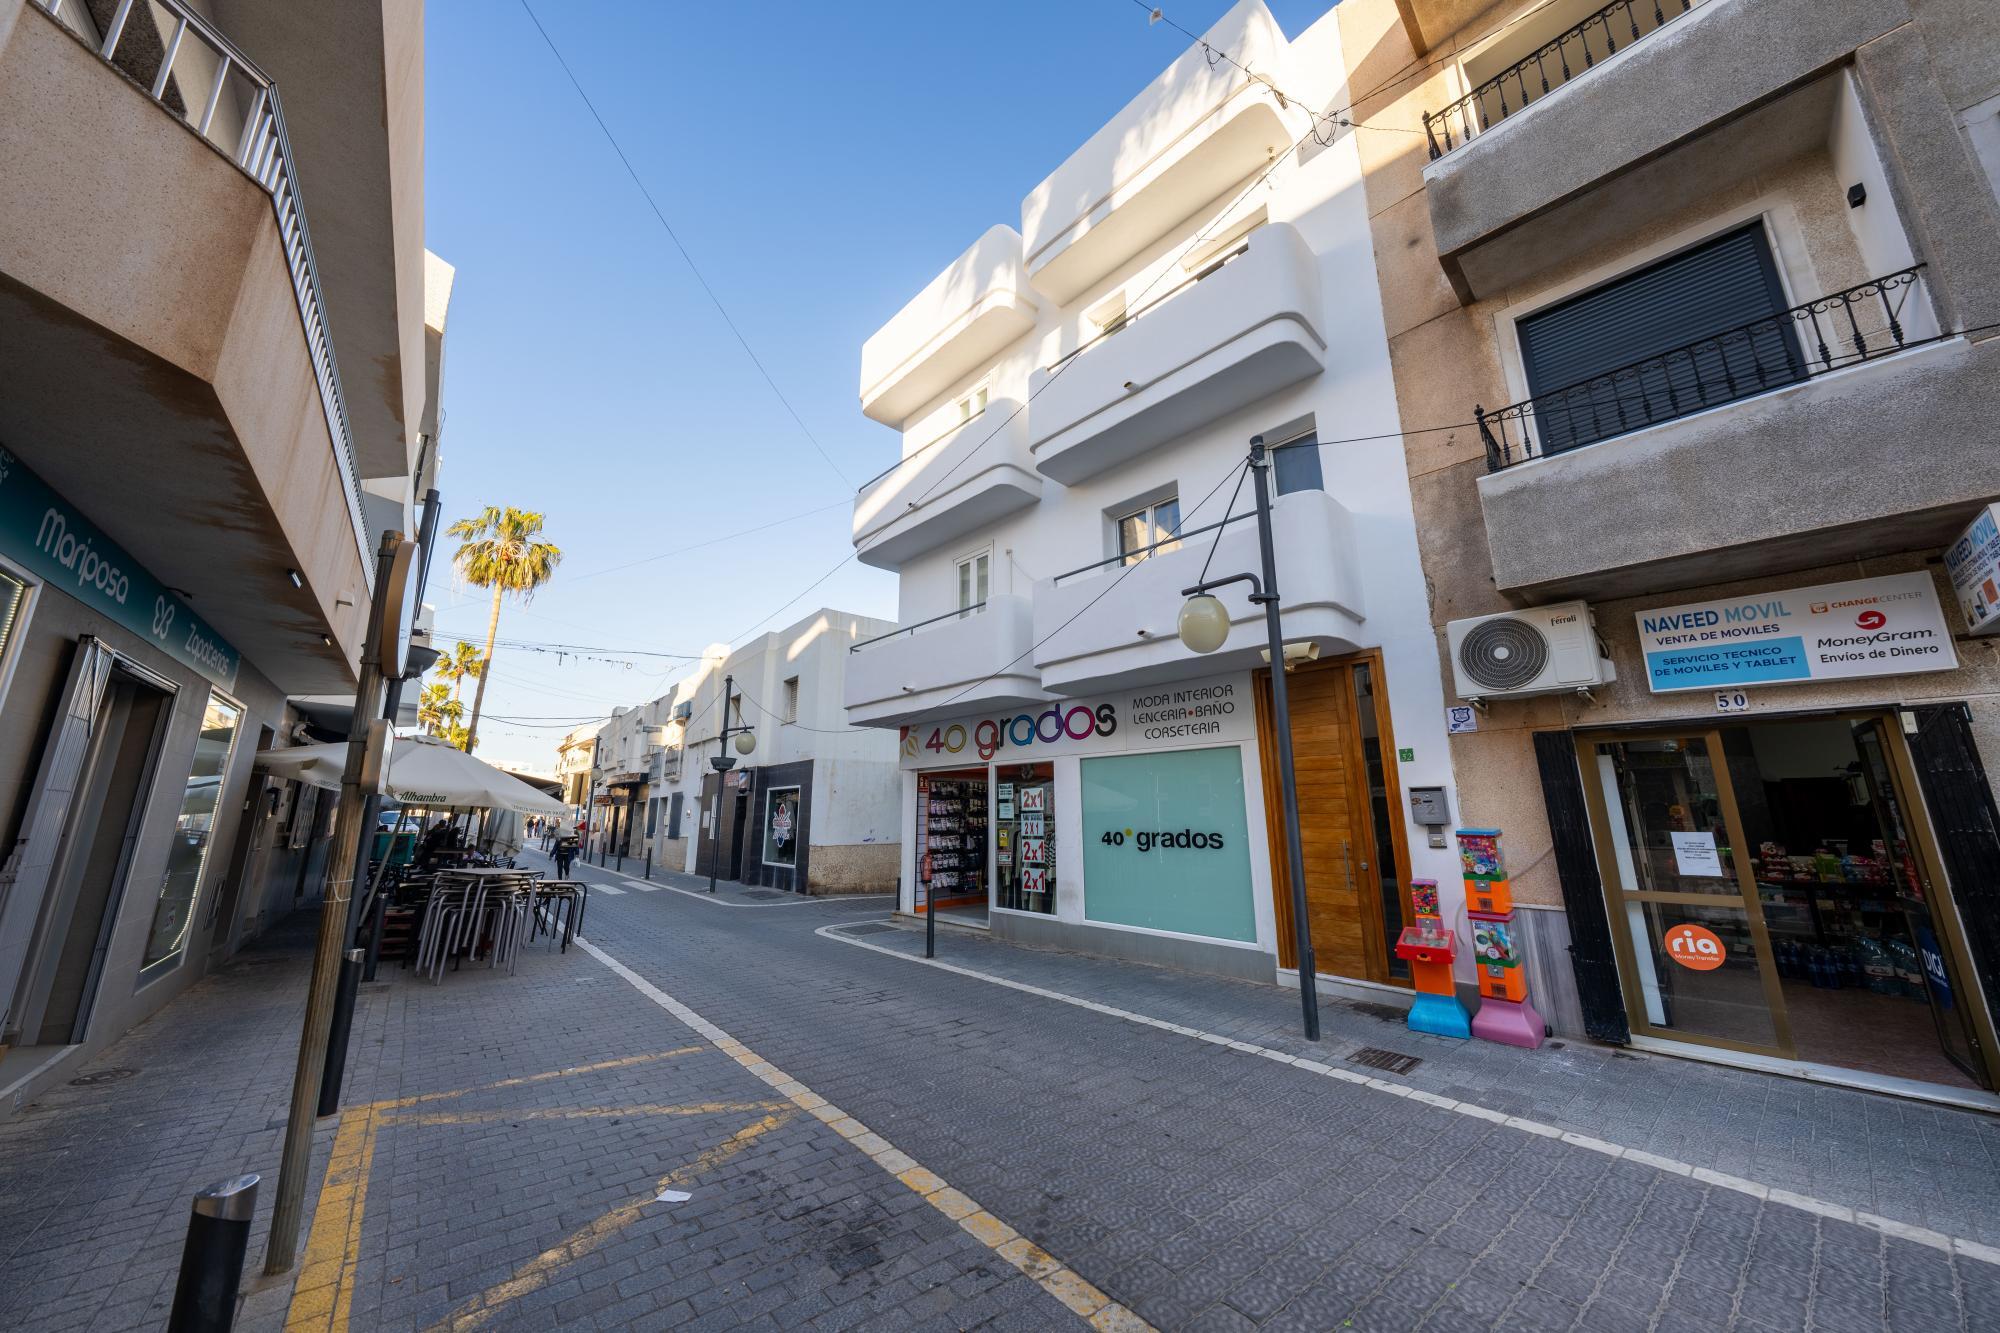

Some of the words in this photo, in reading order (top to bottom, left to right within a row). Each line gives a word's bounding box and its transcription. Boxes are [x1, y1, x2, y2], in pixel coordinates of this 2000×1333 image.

[1944, 537, 1972, 573] NAVEED
[1970, 514, 1997, 549] MOVIL
[35, 507, 129, 605] Mariposa
[1643, 610, 1719, 634] NAVEED
[1724, 601, 1791, 624] MOVIL
[1656, 634, 1698, 646] VENTA
[1701, 631, 1718, 641] DE
[1721, 623, 1780, 639] MOVILES
[1817, 629, 1933, 649] MoneyGram
[1662, 653, 1720, 666] SERVICIO
[1722, 646, 1782, 660] TECNICO
[1820, 649, 1865, 663] Envíos
[1868, 649, 1887, 660] de
[1890, 645, 1939, 657] Dinero
[1655, 668, 1671, 677] DE
[1674, 662, 1729, 676] MOVILES
[1732, 661, 1741, 669] Y
[1743, 656, 1797, 668] TABLET
[1132, 694, 1170, 710] MODA
[1174, 684, 1234, 704] INTERIOR
[1718, 694, 1746, 708] 50
[1133, 707, 1187, 725] LENCERIA
[1195, 701, 1235, 718] BAÑO
[925, 724, 968, 754] 40
[974, 703, 1118, 761] grados
[1144, 721, 1220, 740] CORSETERIA
[399, 791, 447, 803] Alhambra
[1023, 789, 1043, 809] 2x1
[1023, 840, 1045, 861] 2x1
[1136, 828, 1224, 852] grados
[1023, 869, 1045, 891] 2x1
[1672, 929, 1718, 955] ria
